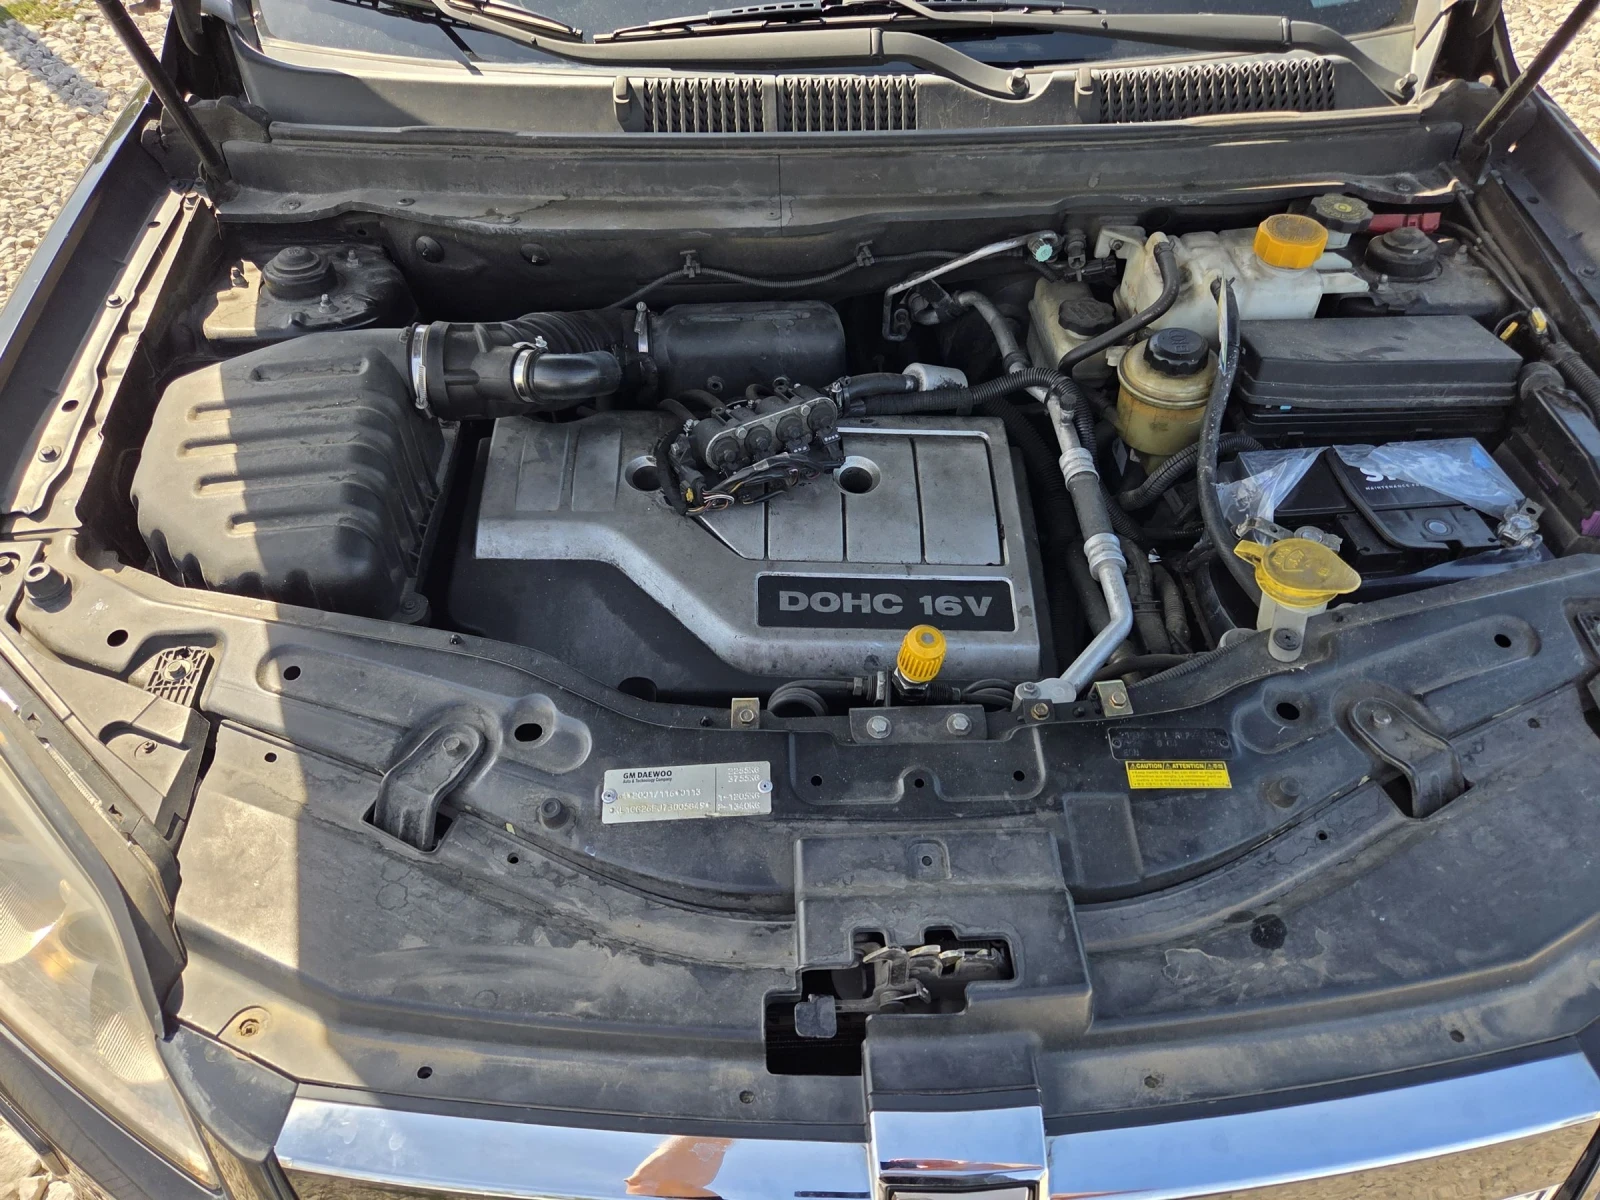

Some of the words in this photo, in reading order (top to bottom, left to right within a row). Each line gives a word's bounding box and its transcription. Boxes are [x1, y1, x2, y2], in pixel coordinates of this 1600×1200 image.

[1365, 483, 1410, 491] MAINTENANCE
[779, 591, 904, 615] DOHC
[920, 595, 993, 617] 16V
[637, 770, 673, 779] DAEWOO
